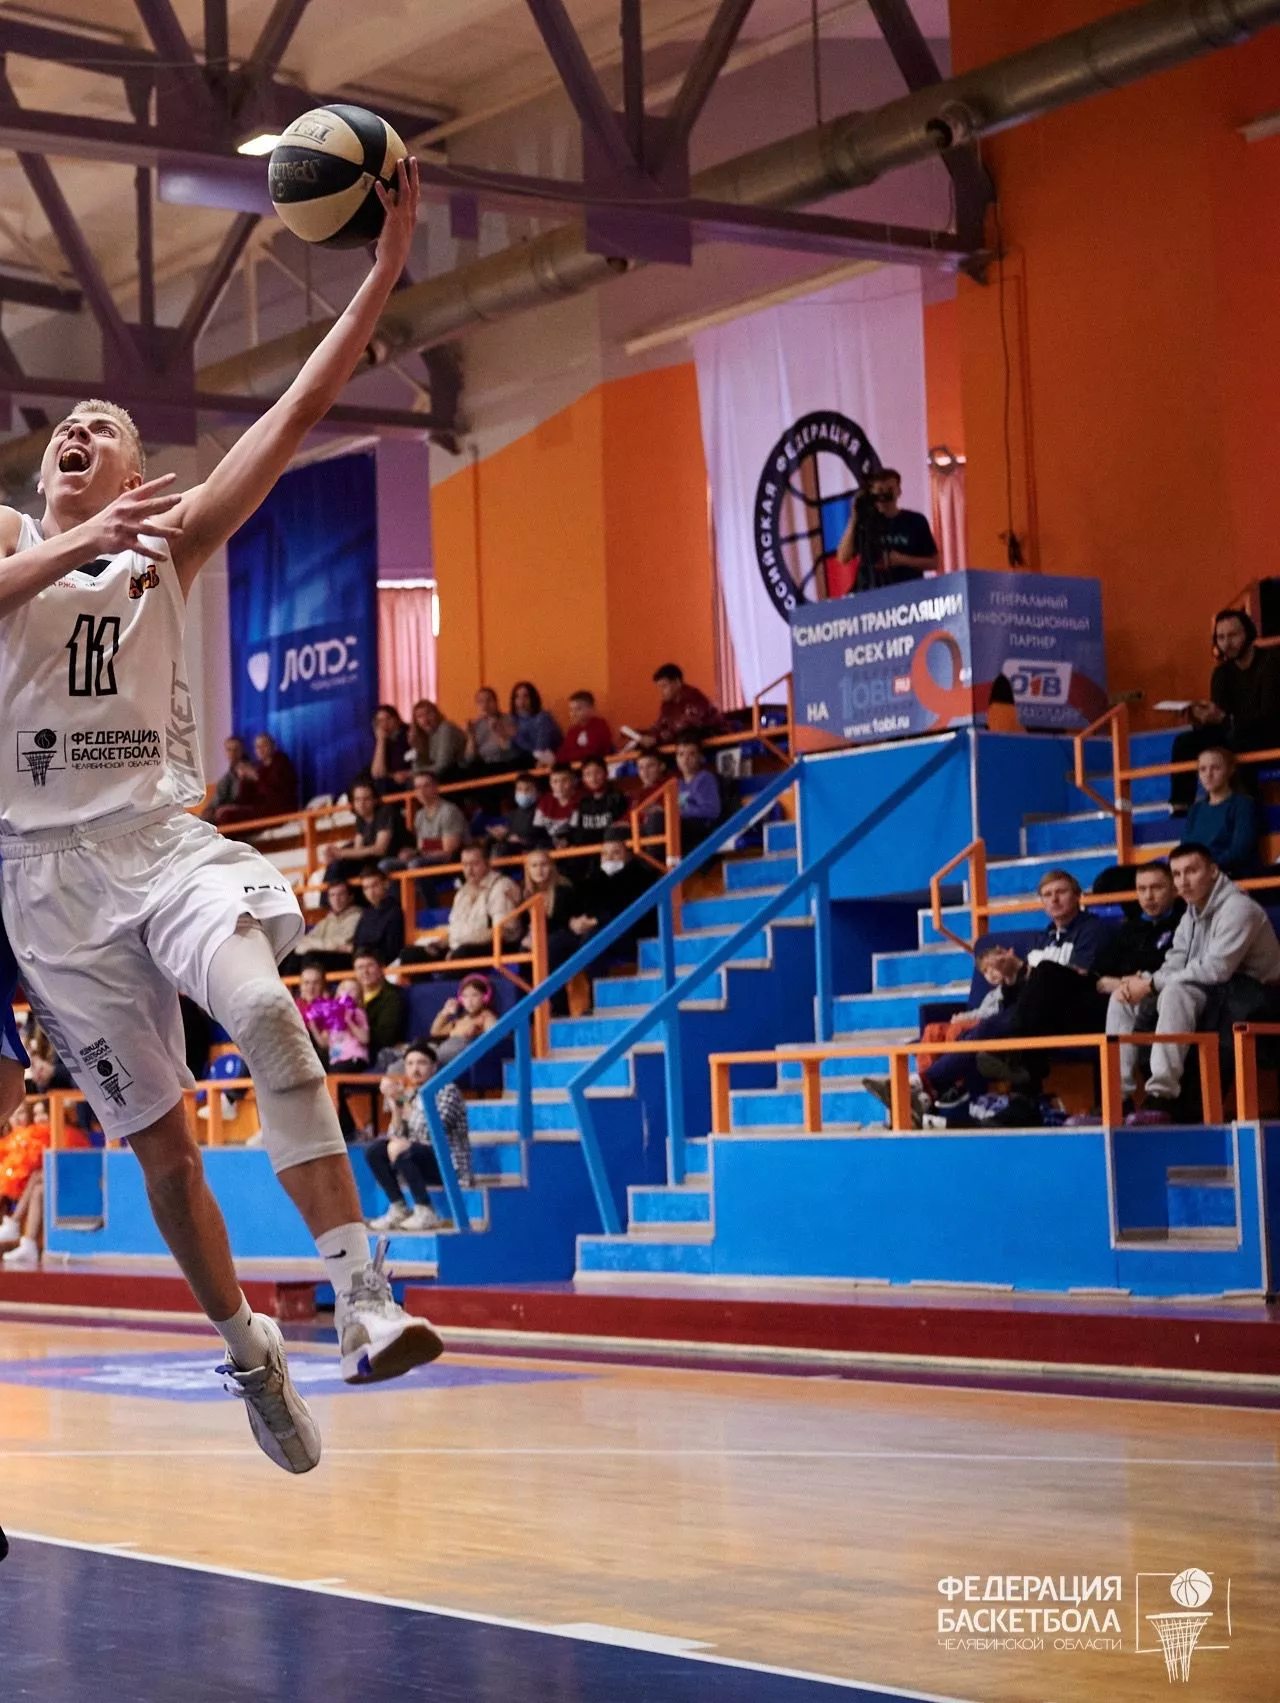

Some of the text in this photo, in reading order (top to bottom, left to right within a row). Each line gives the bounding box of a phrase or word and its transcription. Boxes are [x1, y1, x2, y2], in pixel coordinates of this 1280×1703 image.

[760, 482, 796, 611] ССИЙСКАЯ
[794, 593, 964, 647] СМОТРИ ТРАНСЛЯЦИИ
[844, 635, 915, 667] ВСЕХ ИГР
[807, 701, 829, 721] НА
[71, 729, 161, 746] ФЕДЕРАЦИЯ
[71, 745, 161, 761] БАСКЕТБОЛА
